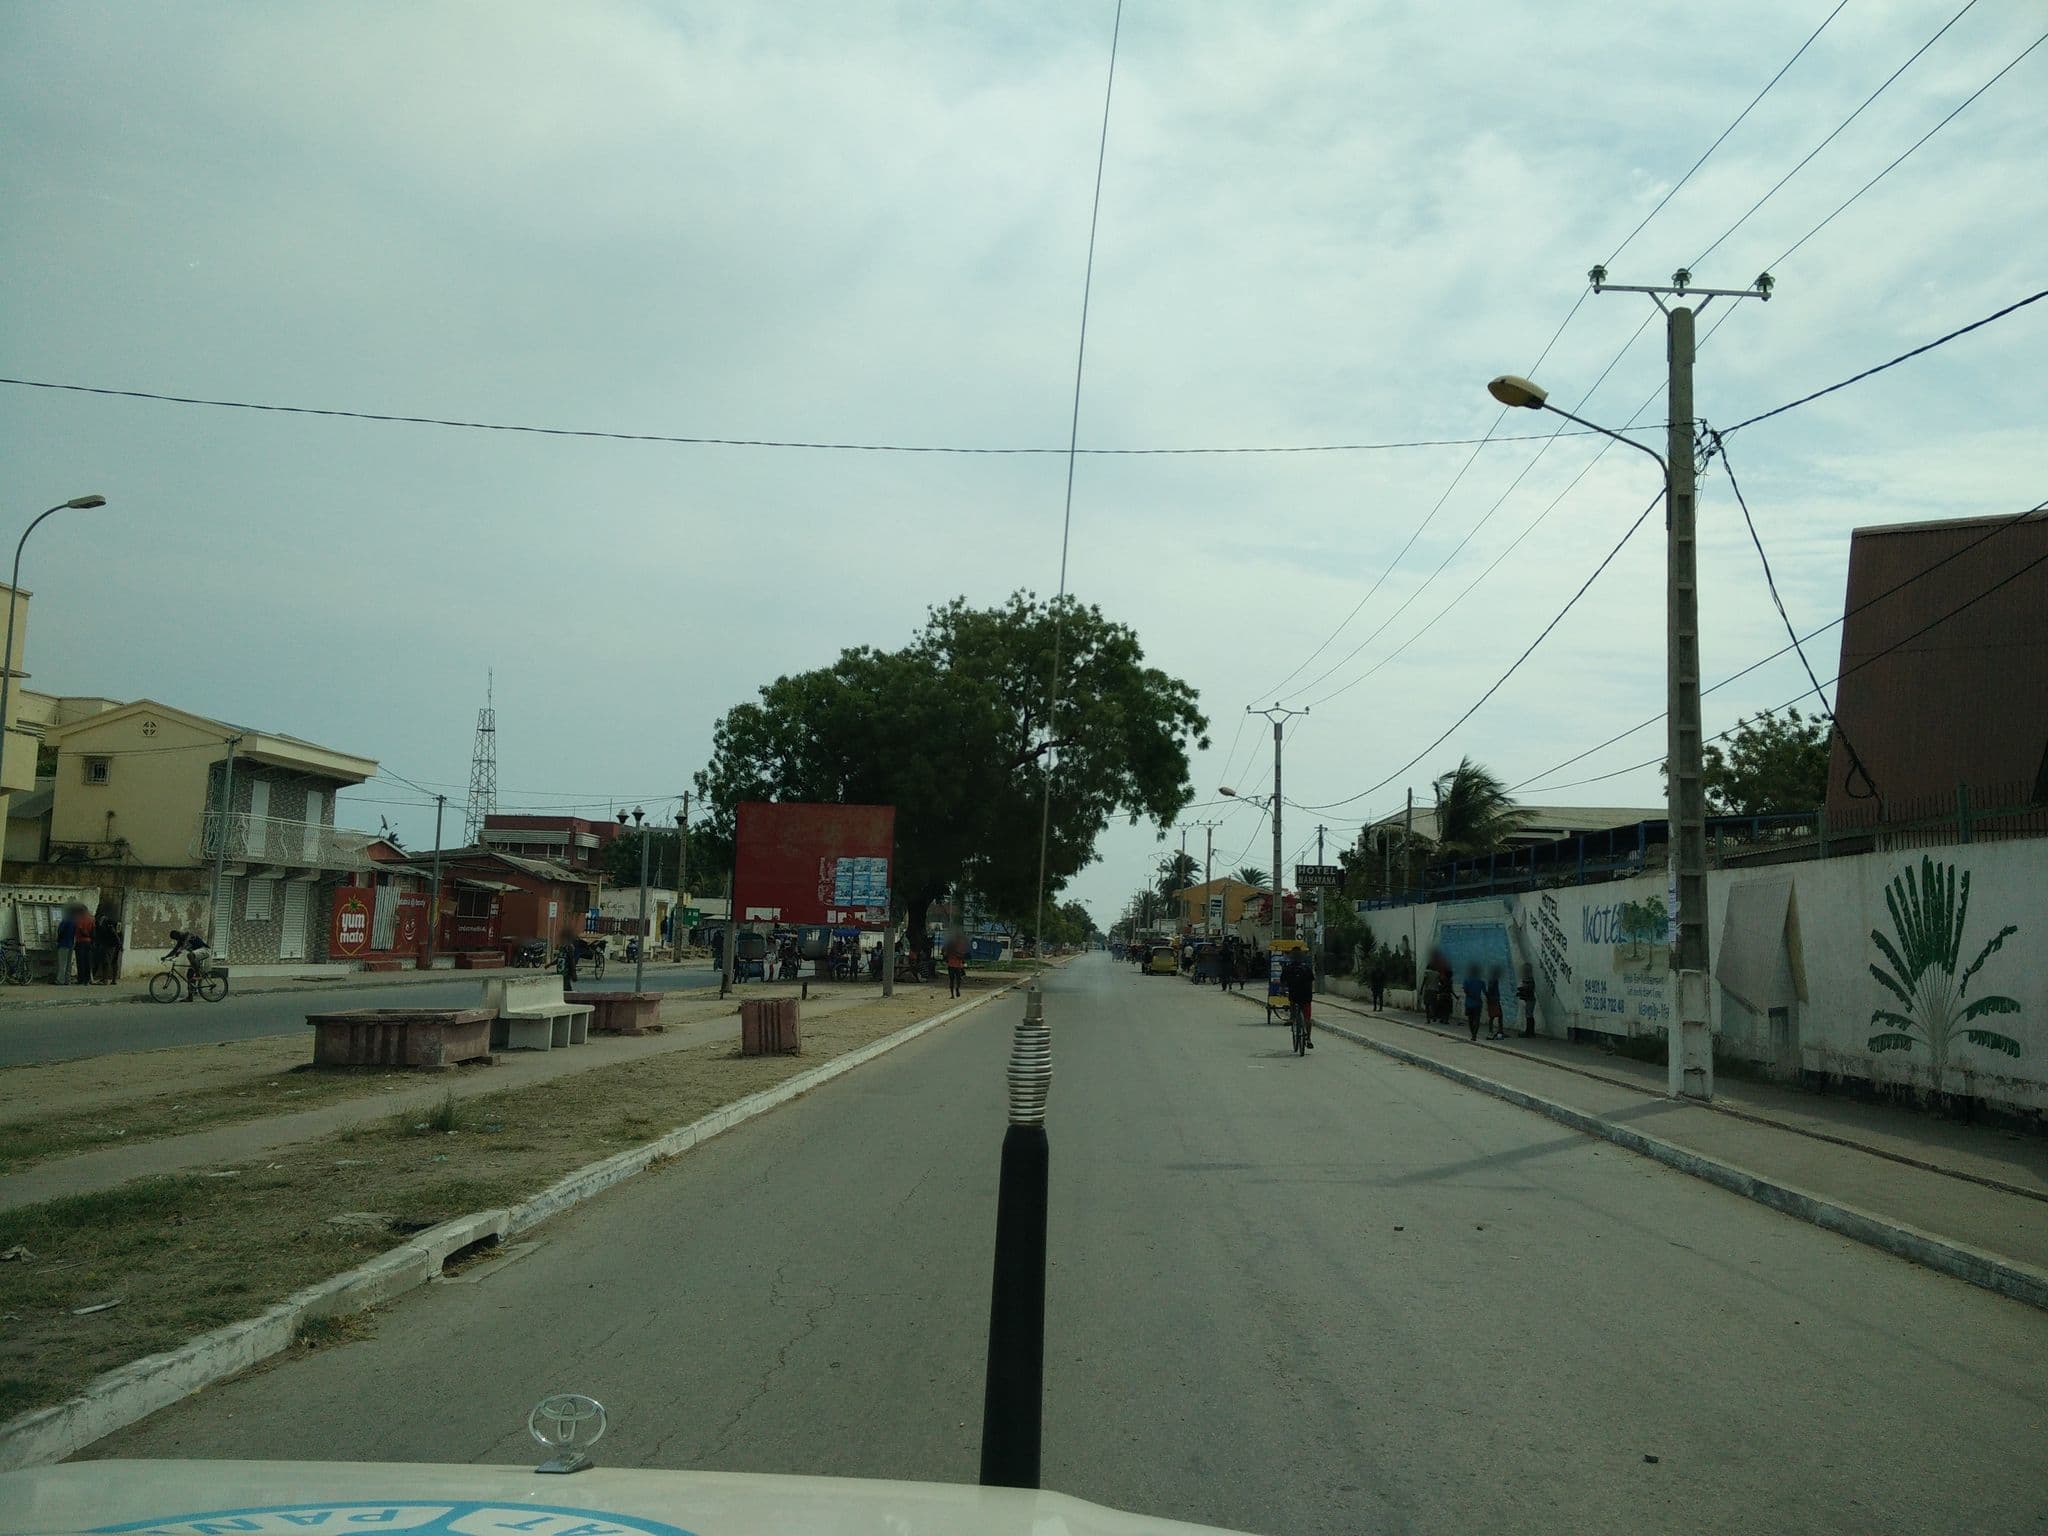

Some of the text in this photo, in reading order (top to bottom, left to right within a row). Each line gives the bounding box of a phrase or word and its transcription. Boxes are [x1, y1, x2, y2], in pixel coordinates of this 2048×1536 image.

[1298, 866, 1337, 875] HOTEL
[341, 912, 365, 932] yum
[339, 930, 364, 944] mato
